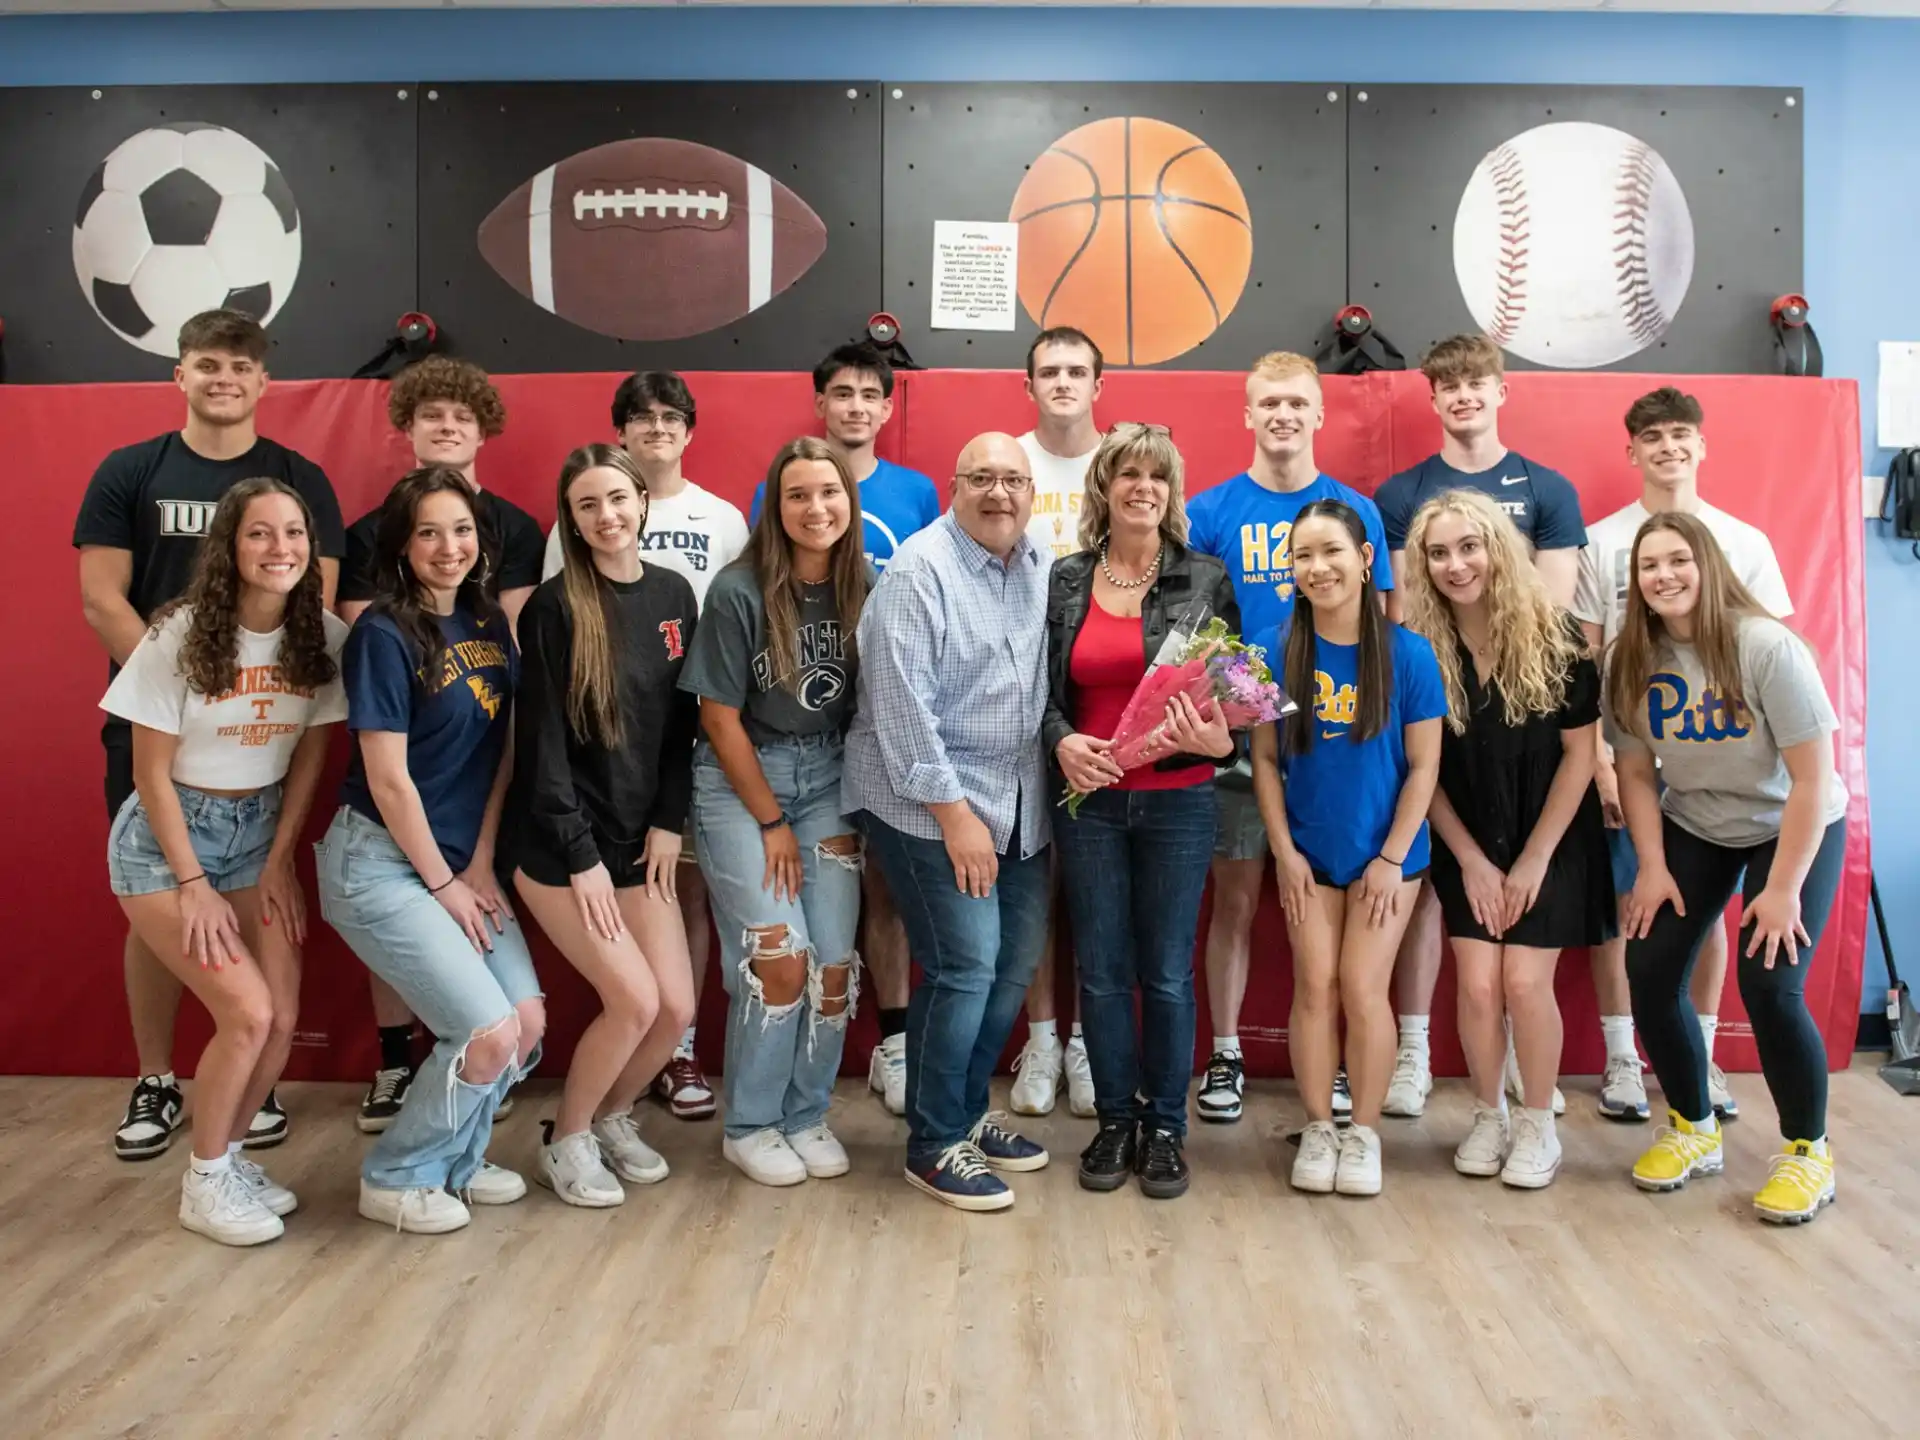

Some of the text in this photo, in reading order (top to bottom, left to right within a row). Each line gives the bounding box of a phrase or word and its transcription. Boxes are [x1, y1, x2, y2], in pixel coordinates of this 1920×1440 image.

[953, 244, 966, 252] gym
[637, 530, 710, 553] YTON
[1243, 574, 1267, 584] HAIL
[1270, 572, 1283, 582] TO
[752, 624, 817, 693] PN
[251, 699, 274, 720] T
[217, 723, 299, 736] VOLUNTEERS
